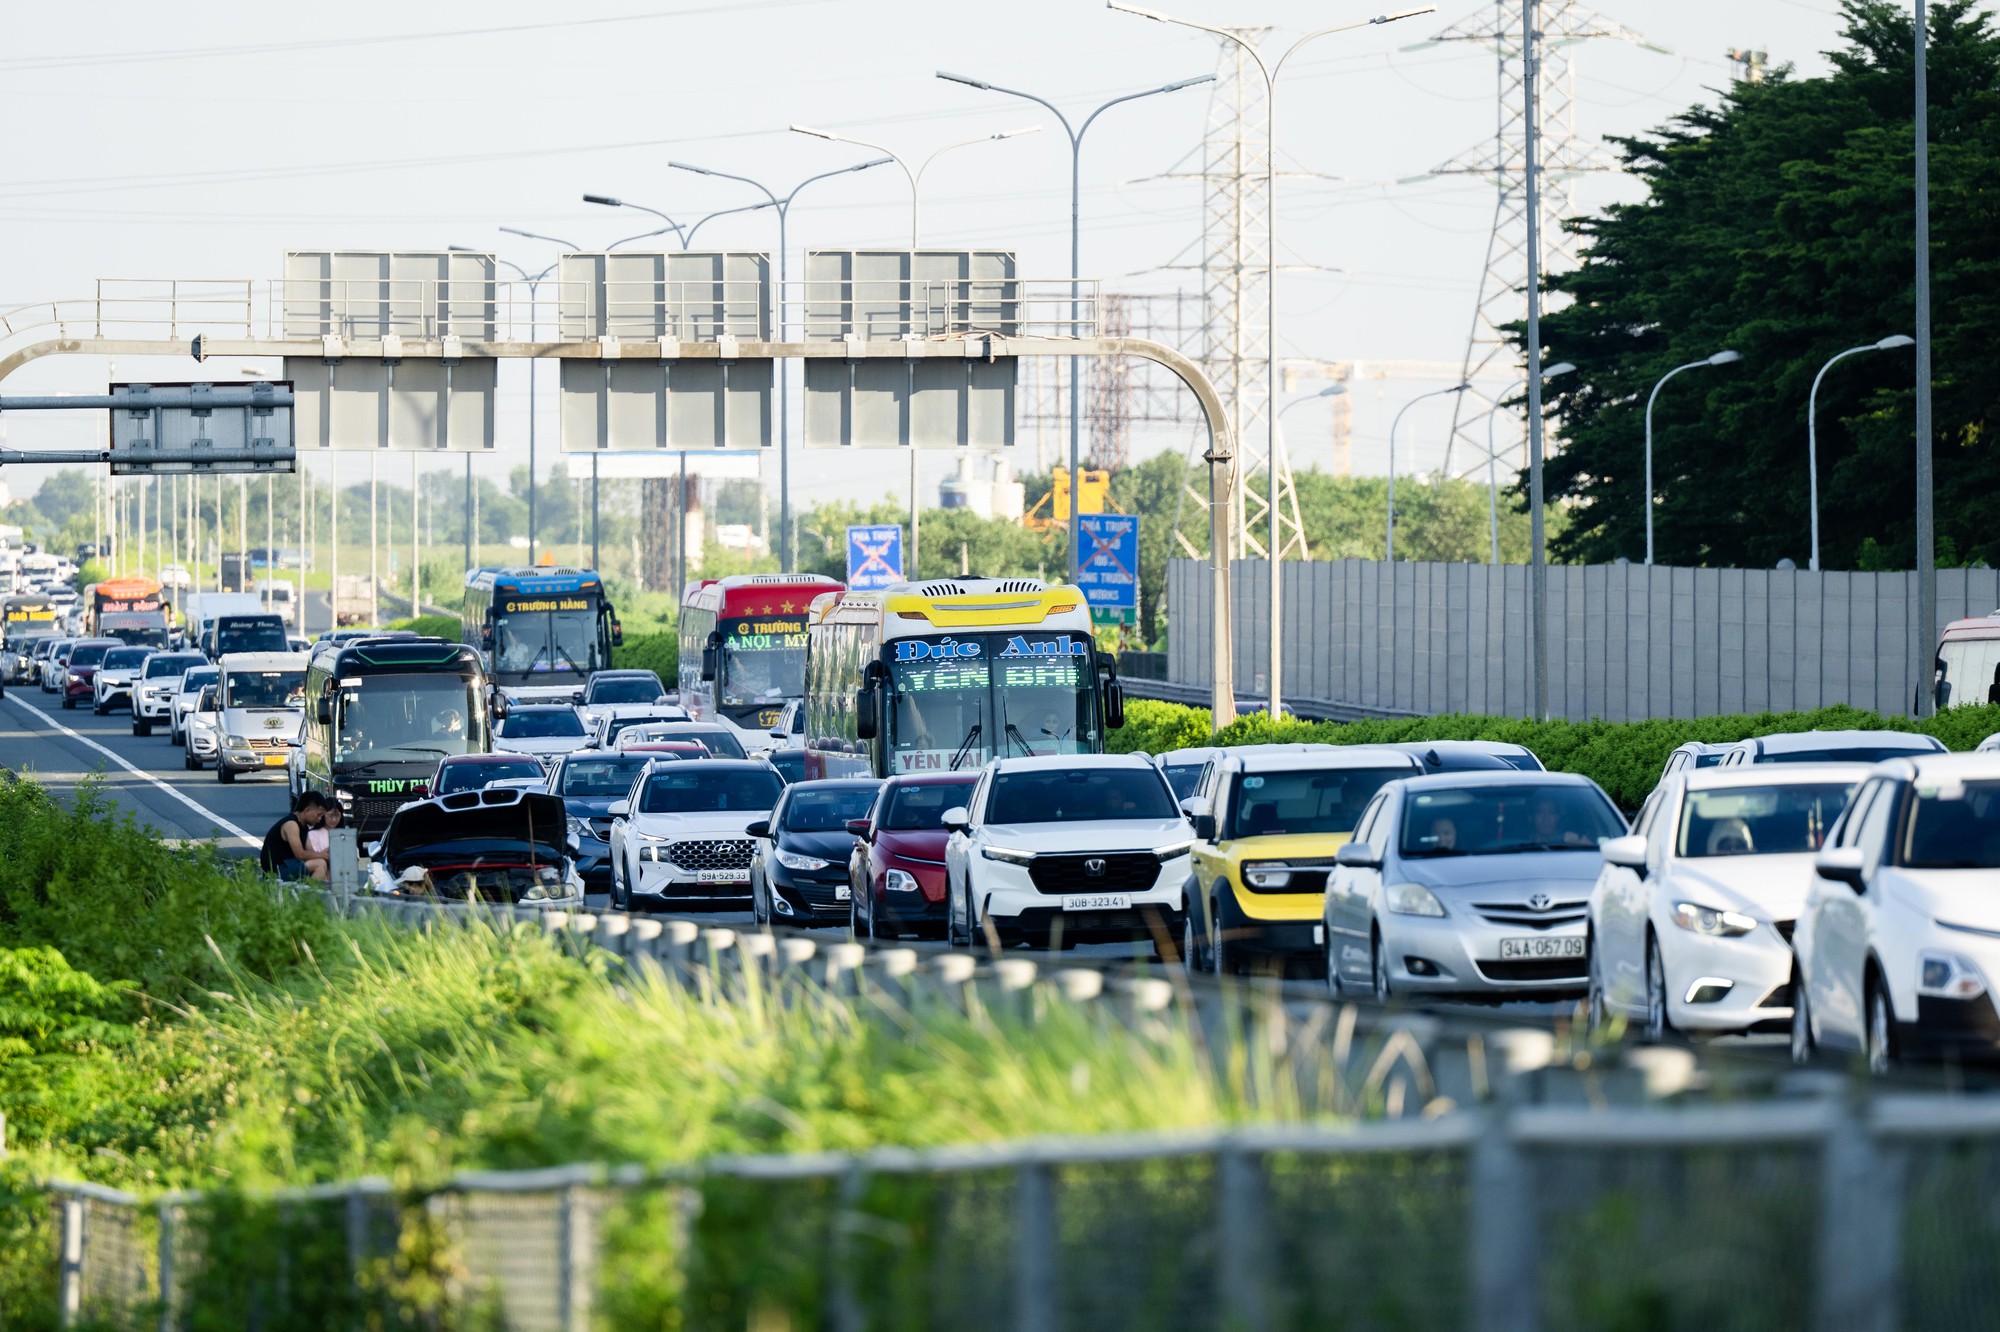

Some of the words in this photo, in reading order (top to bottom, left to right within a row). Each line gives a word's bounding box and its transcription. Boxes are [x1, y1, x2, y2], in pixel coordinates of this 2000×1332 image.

[753, 620, 801, 634] TRƯỜNG
[895, 636, 981, 661] Đức
[1000, 635, 1086, 656] Anh
[901, 751, 941, 769] YÊN
[368, 778, 406, 793] THÙY
